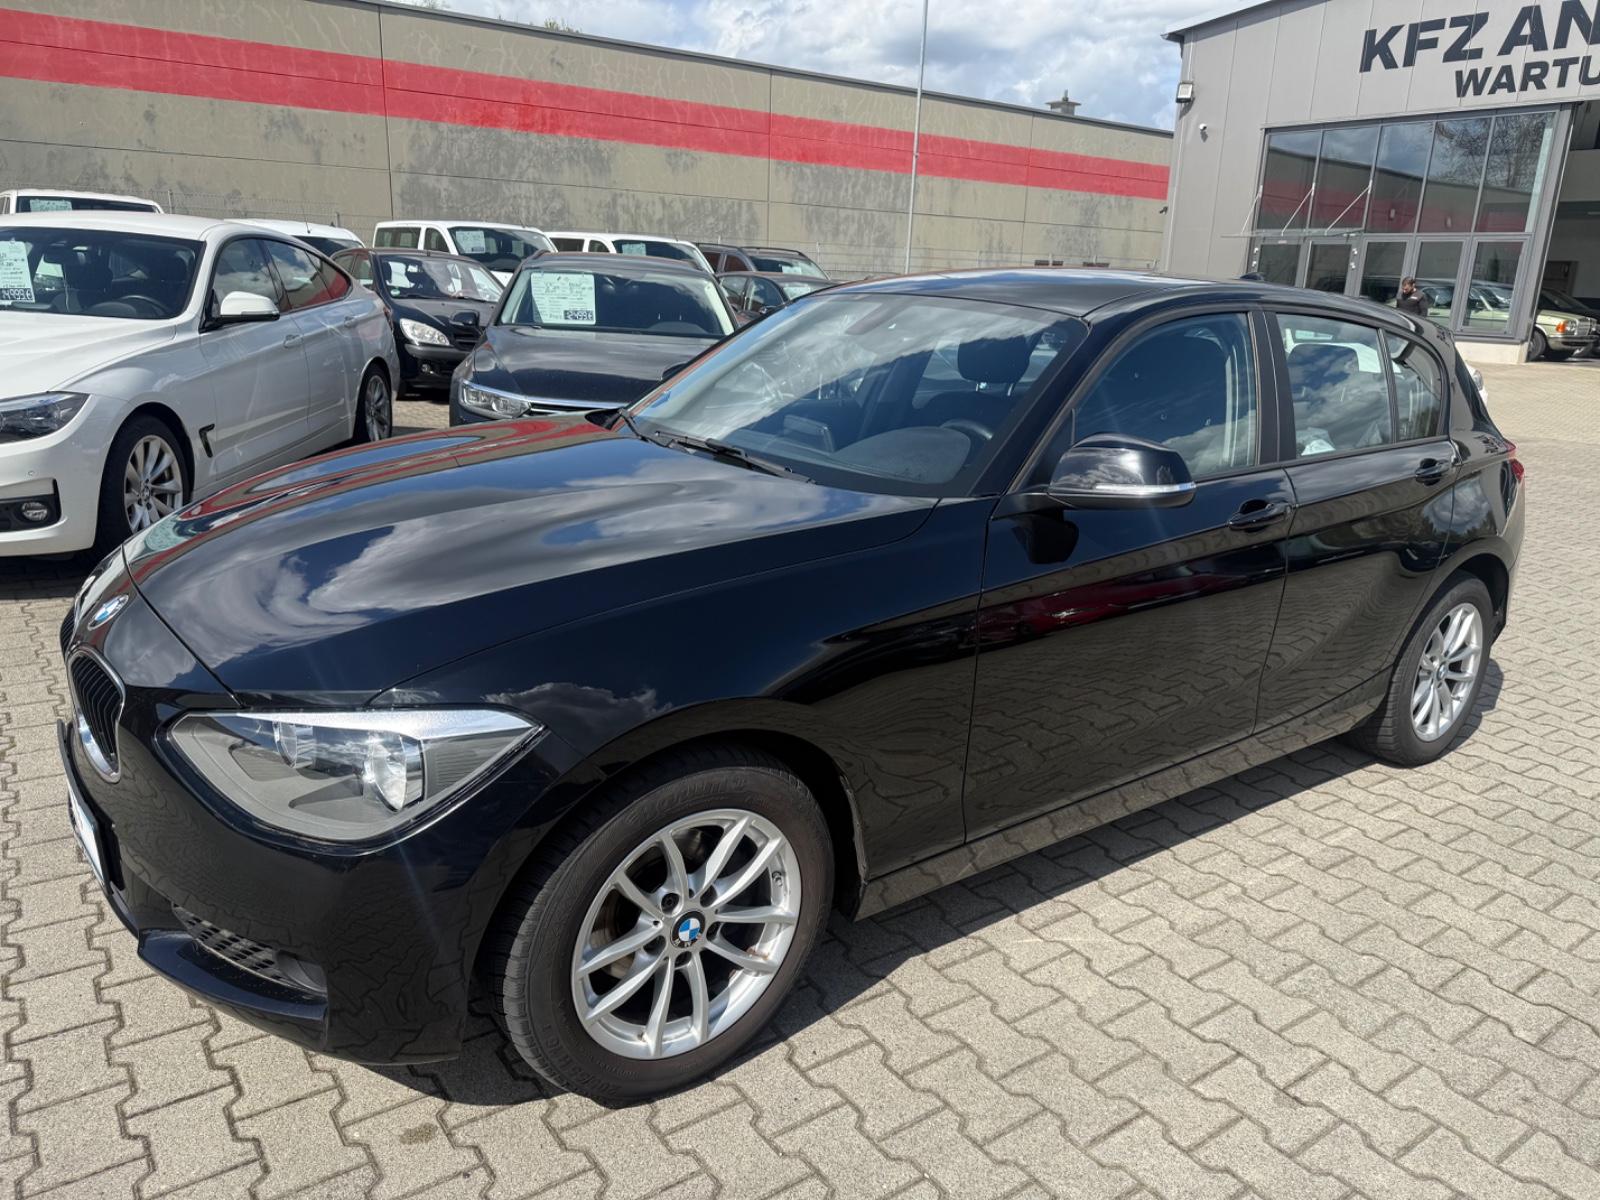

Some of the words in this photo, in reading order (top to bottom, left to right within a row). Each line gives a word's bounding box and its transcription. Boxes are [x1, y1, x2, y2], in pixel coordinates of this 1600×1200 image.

[1359, 12, 1489, 73] KFZ
[1497, 0, 1600, 56] AN
[1455, 55, 1600, 98] WARTU
